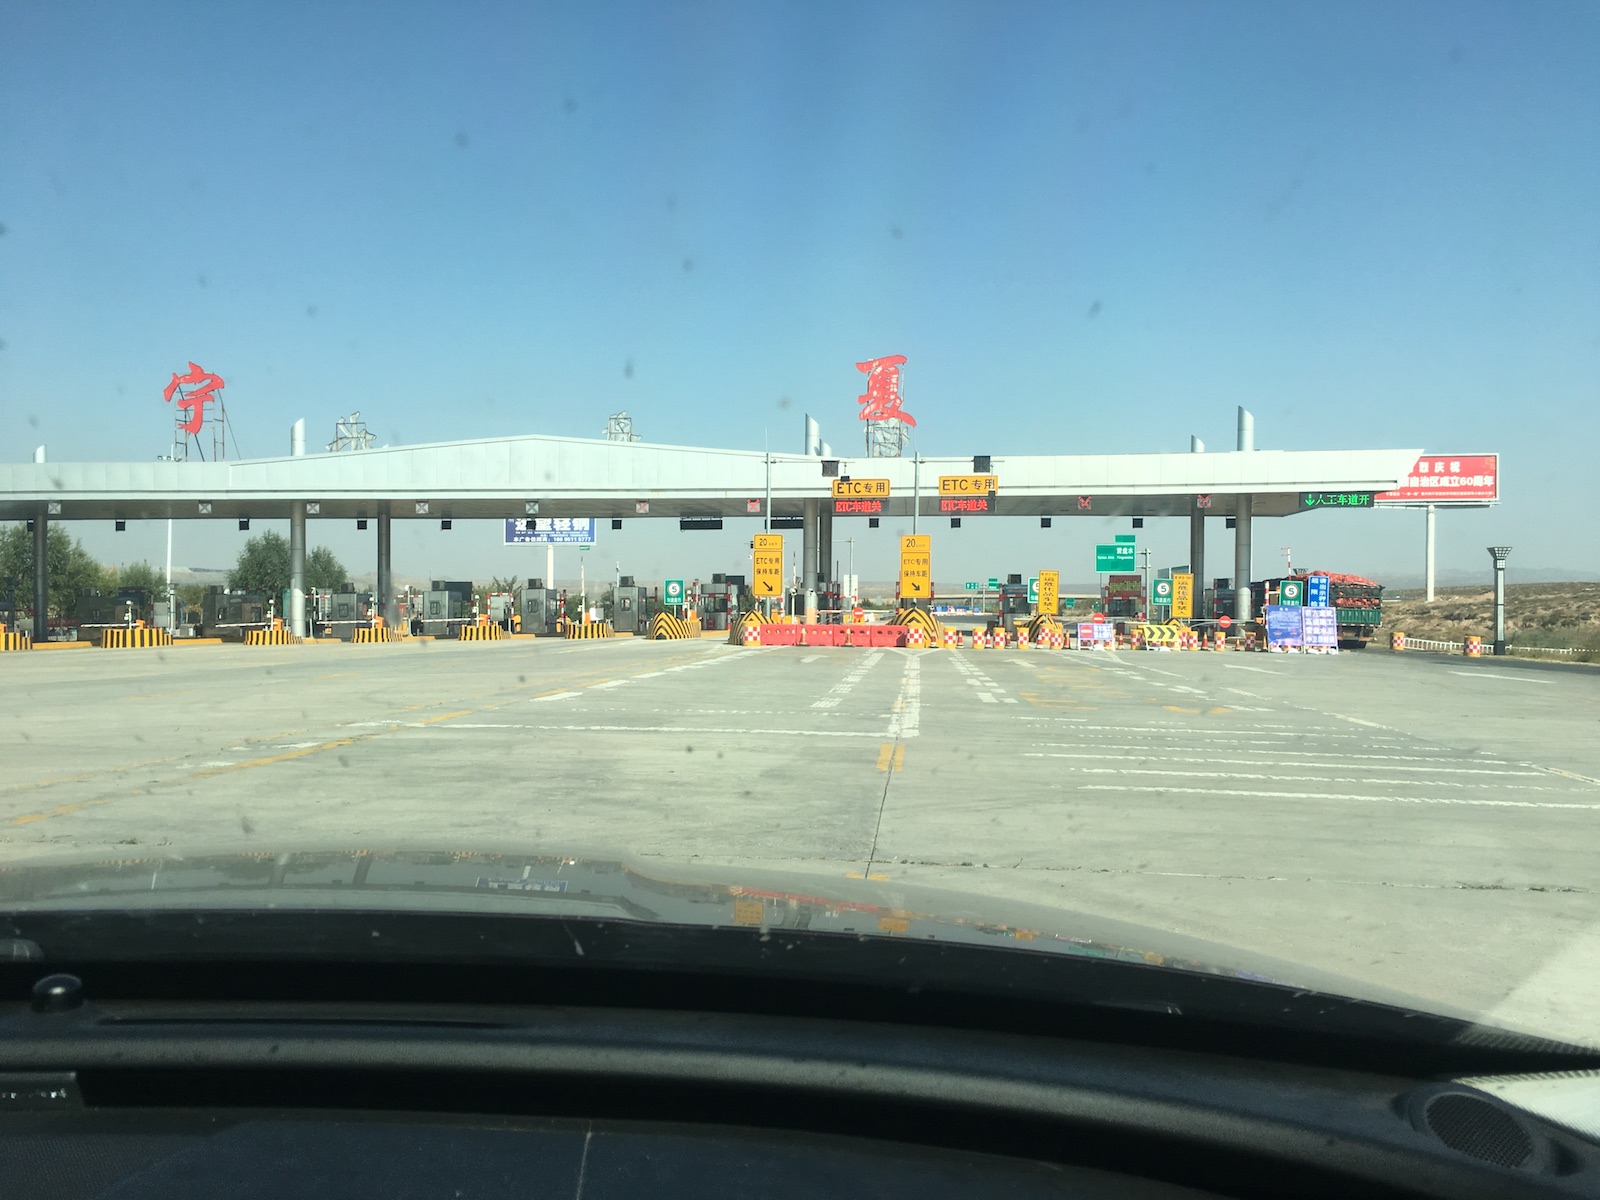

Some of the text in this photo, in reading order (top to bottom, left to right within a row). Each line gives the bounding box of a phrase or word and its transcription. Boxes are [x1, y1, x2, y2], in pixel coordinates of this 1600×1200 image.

[163, 353, 917, 435] 宁 夏
[1413, 461, 1461, 473] 烈庆祝
[941, 499, 988, 512] ETC车道关
[1315, 494, 1369, 506] 人工车道开
[835, 500, 882, 513] ETC车道关
[759, 538, 767, 546] 20
[906, 538, 915, 547] 20
